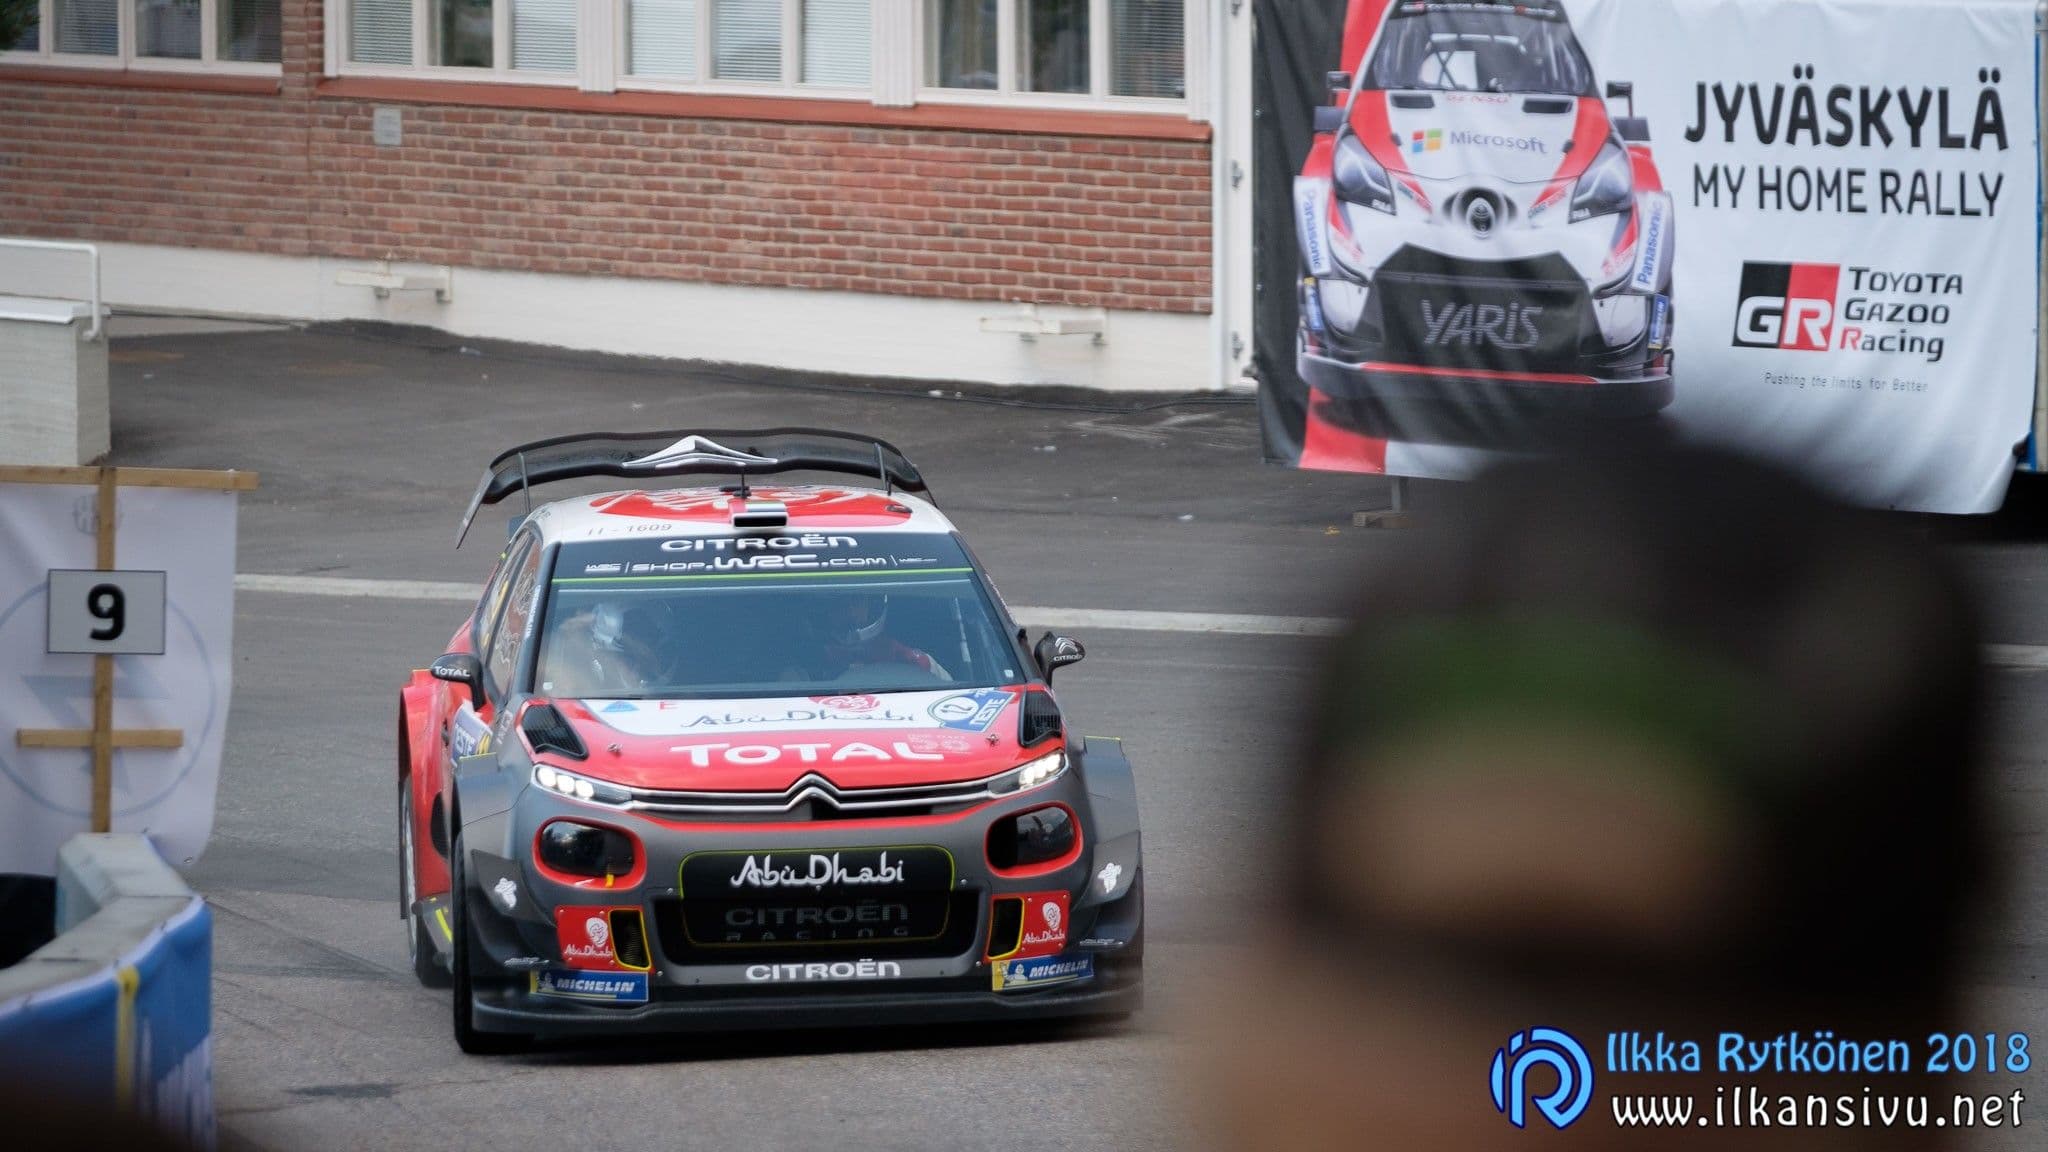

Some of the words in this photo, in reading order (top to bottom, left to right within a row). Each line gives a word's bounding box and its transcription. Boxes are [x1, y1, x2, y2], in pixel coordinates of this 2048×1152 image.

[1684, 62, 2009, 151] JYVÄSKYLÄ
[1450, 130, 1548, 154] Microsoft
[1693, 163, 1746, 209] MY
[1758, 165, 1868, 214] HOME
[1879, 168, 2005, 217] RALLY
[1303, 188, 1322, 270] Panasonic
[1636, 200, 1664, 285] Panasonic
[1848, 265, 1964, 296] TOYOTA
[1736, 295, 1834, 349] GR
[1844, 296, 1951, 326] GAZOO
[1839, 325, 1946, 363] Racing
[1763, 371, 1806, 389] Pushing
[1811, 373, 1828, 388] the
[1831, 375, 1862, 390] limits
[1869, 376, 1888, 391] for
[1892, 377, 1929, 392] Better
[87, 582, 126, 642] 9
[434, 665, 470, 678] TOTAL
[669, 741, 946, 768] TOTAL
[730, 853, 797, 887] Abu
[808, 850, 905, 892] Dhabi
[745, 957, 902, 982] CITROËN
[1028, 959, 1090, 979] MICHELIN
[556, 977, 636, 993] MICHELIN
